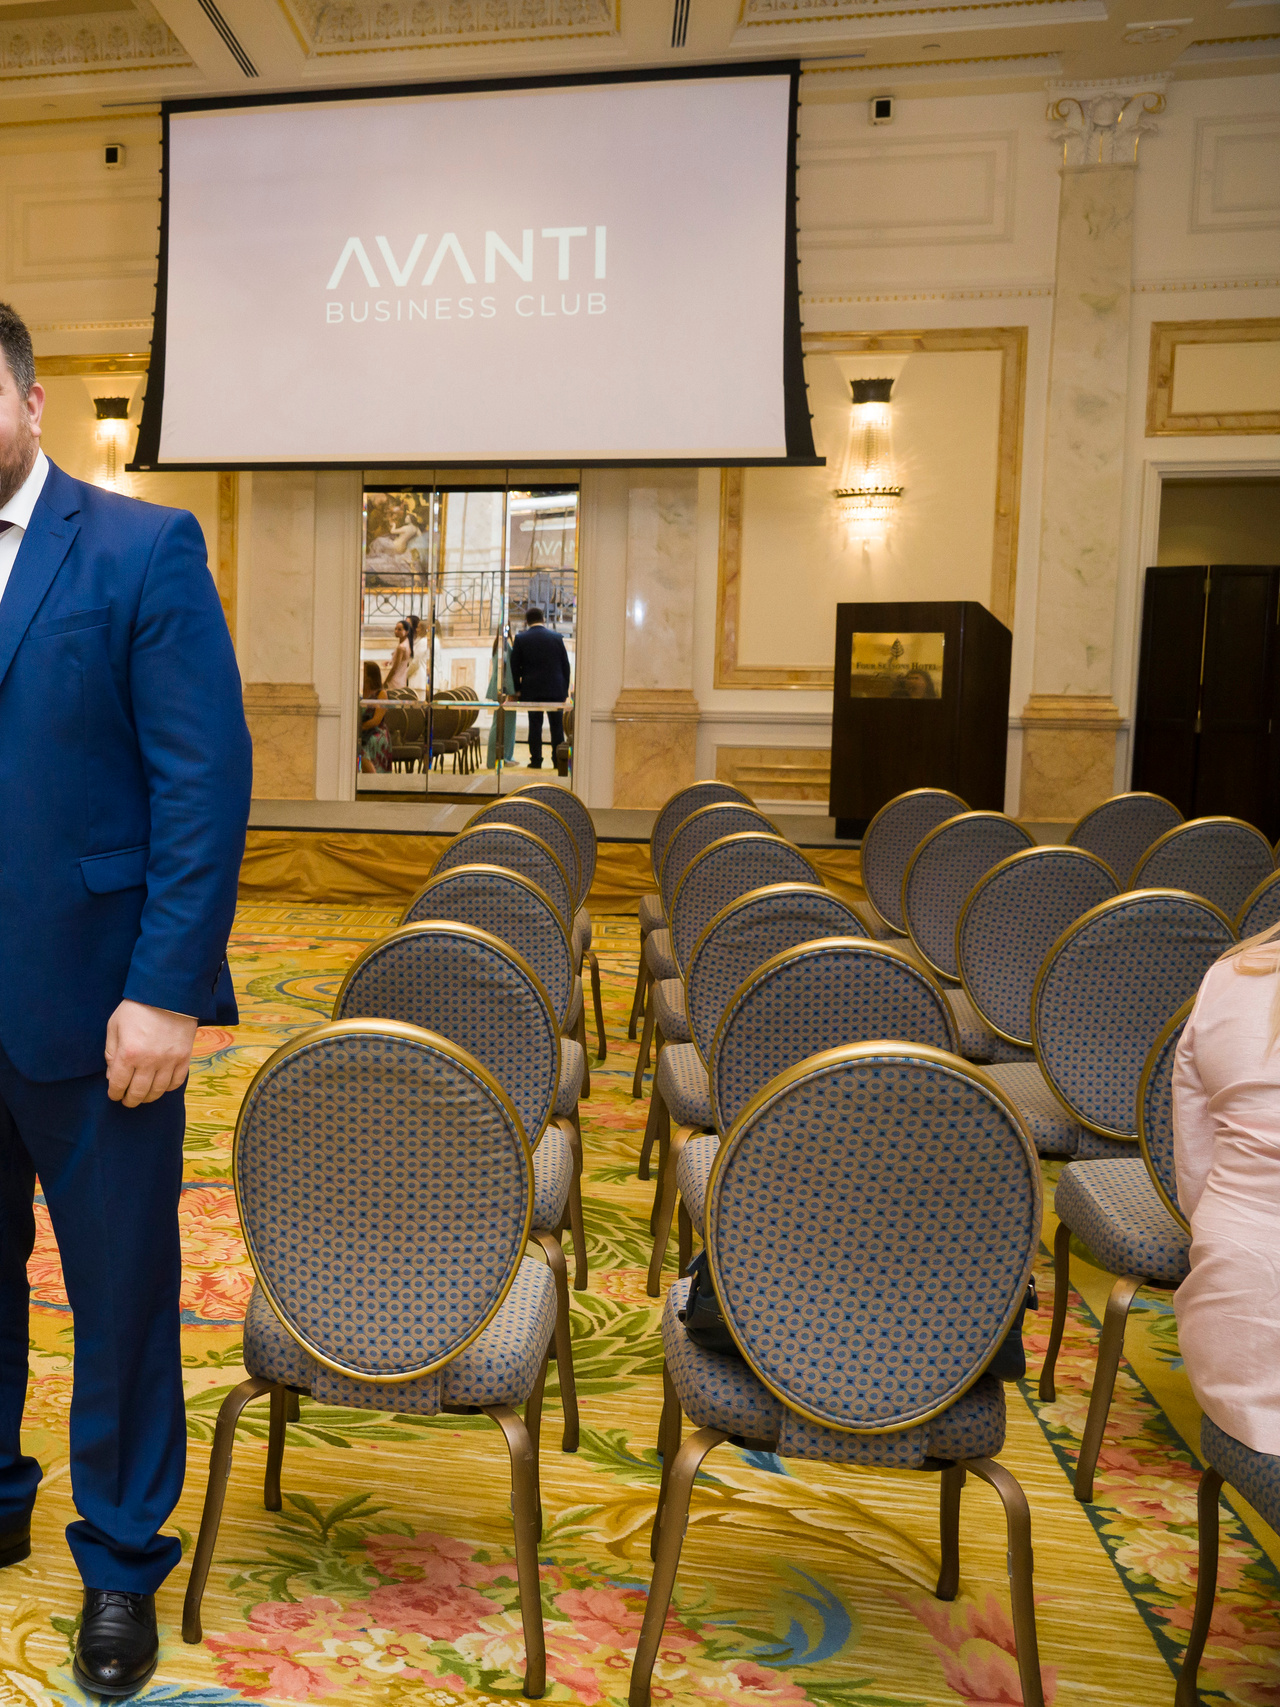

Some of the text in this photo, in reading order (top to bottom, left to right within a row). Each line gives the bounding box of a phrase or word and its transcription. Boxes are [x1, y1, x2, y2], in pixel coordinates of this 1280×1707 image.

[325, 225, 607, 290] AVANTI
[326, 292, 607, 324] BUSINESS CLUB
